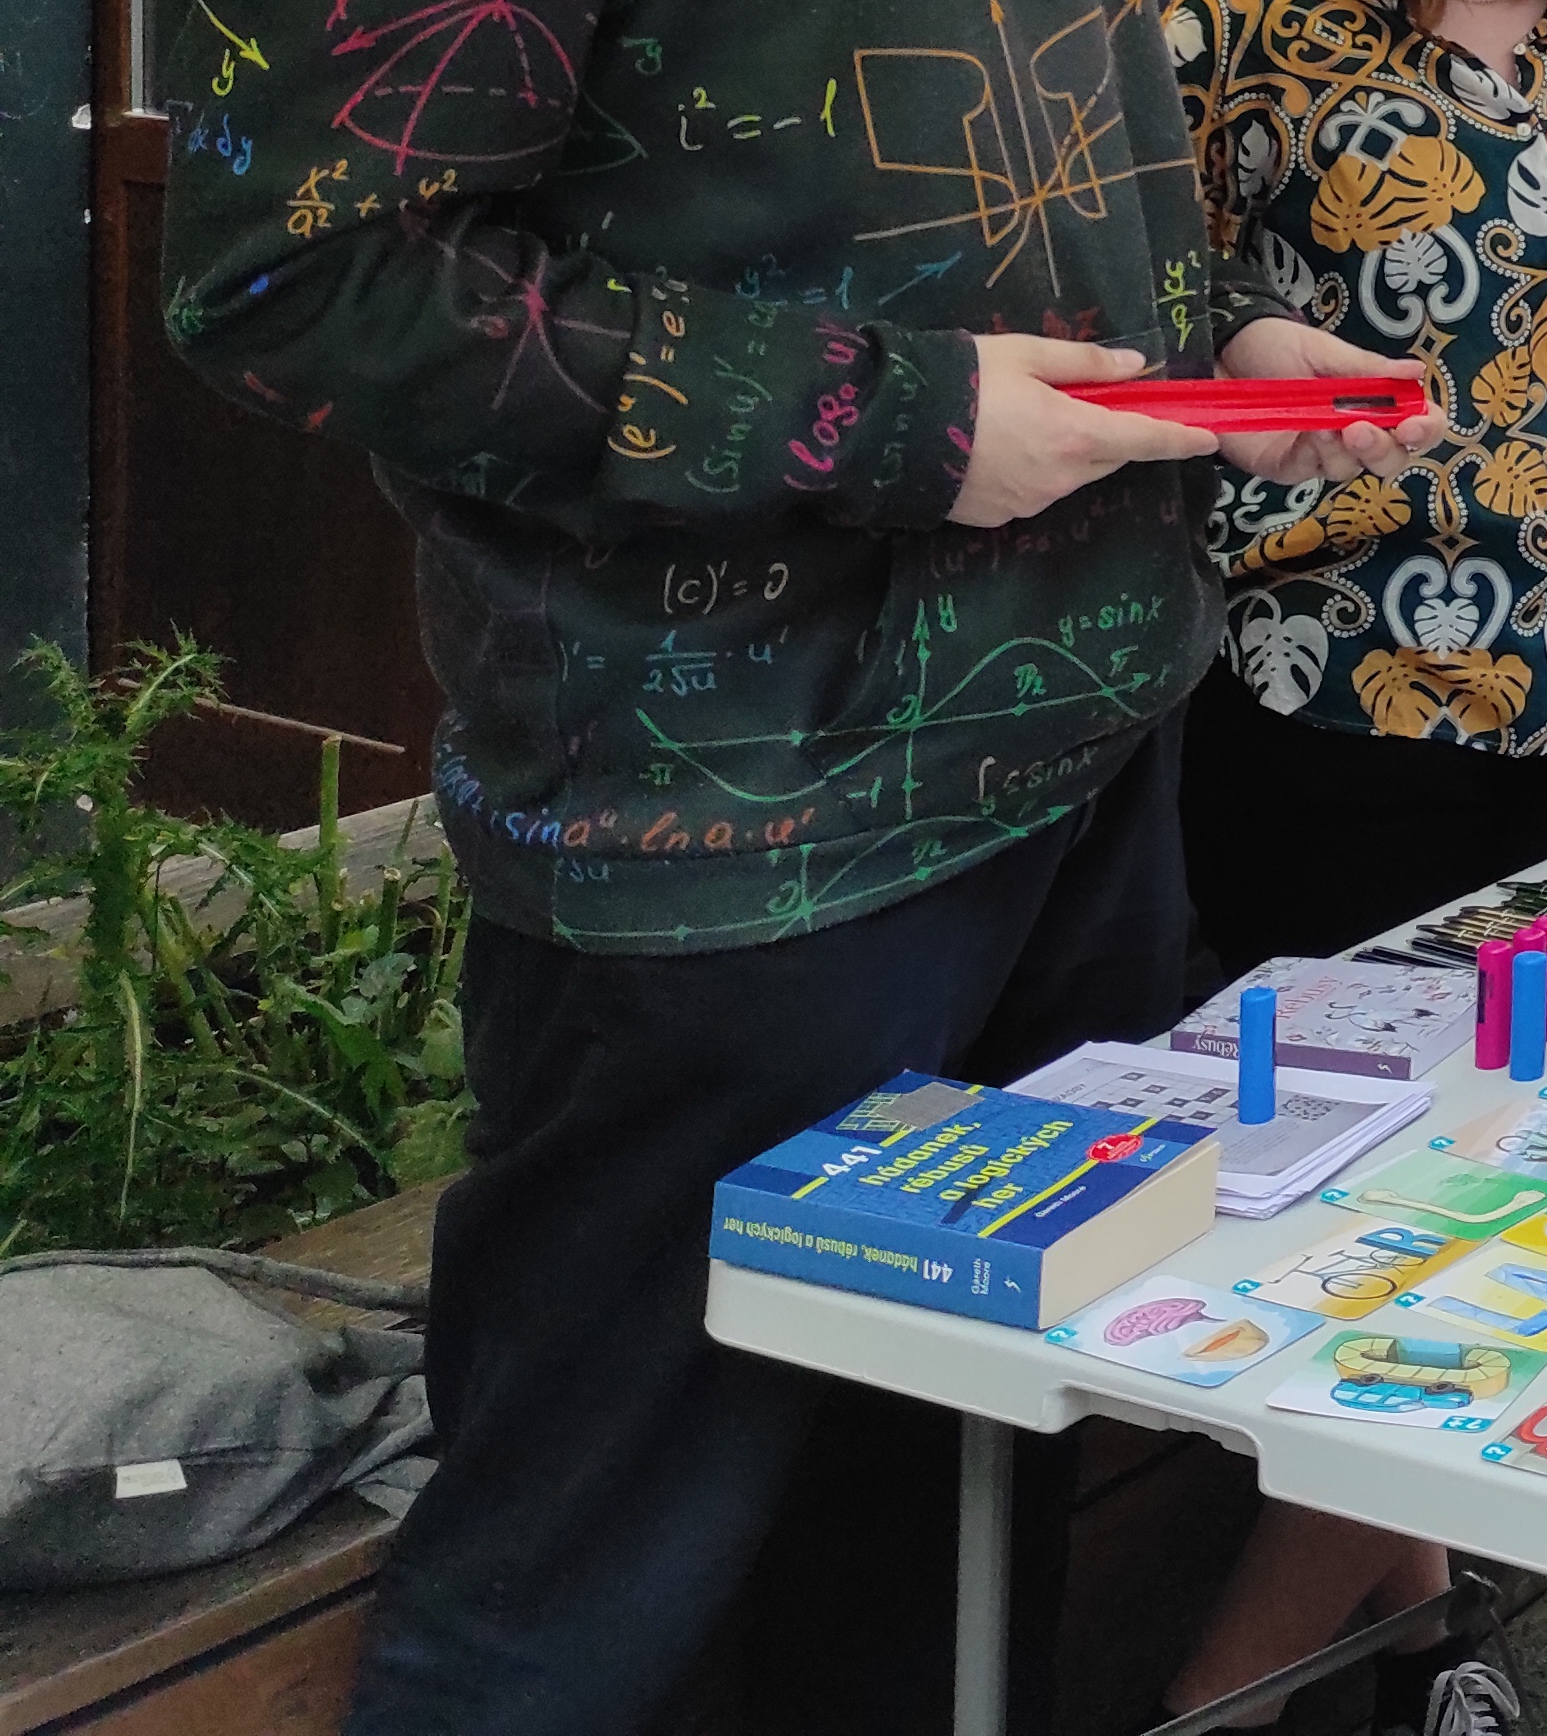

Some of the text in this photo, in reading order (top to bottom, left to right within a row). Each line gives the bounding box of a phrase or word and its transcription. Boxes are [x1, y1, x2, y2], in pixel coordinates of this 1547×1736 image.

[822, 1145, 882, 1178] 441
[858, 1121, 982, 1187] hádanek,
[951, 1119, 1075, 1193] logických
[900, 1144, 990, 1194] rébusů
[939, 1185, 966, 1202] a
[971, 1182, 1024, 1210] her
[723, 1216, 743, 1233] her
[805, 1234, 813, 1249] a
[922, 1259, 953, 1283] 441
